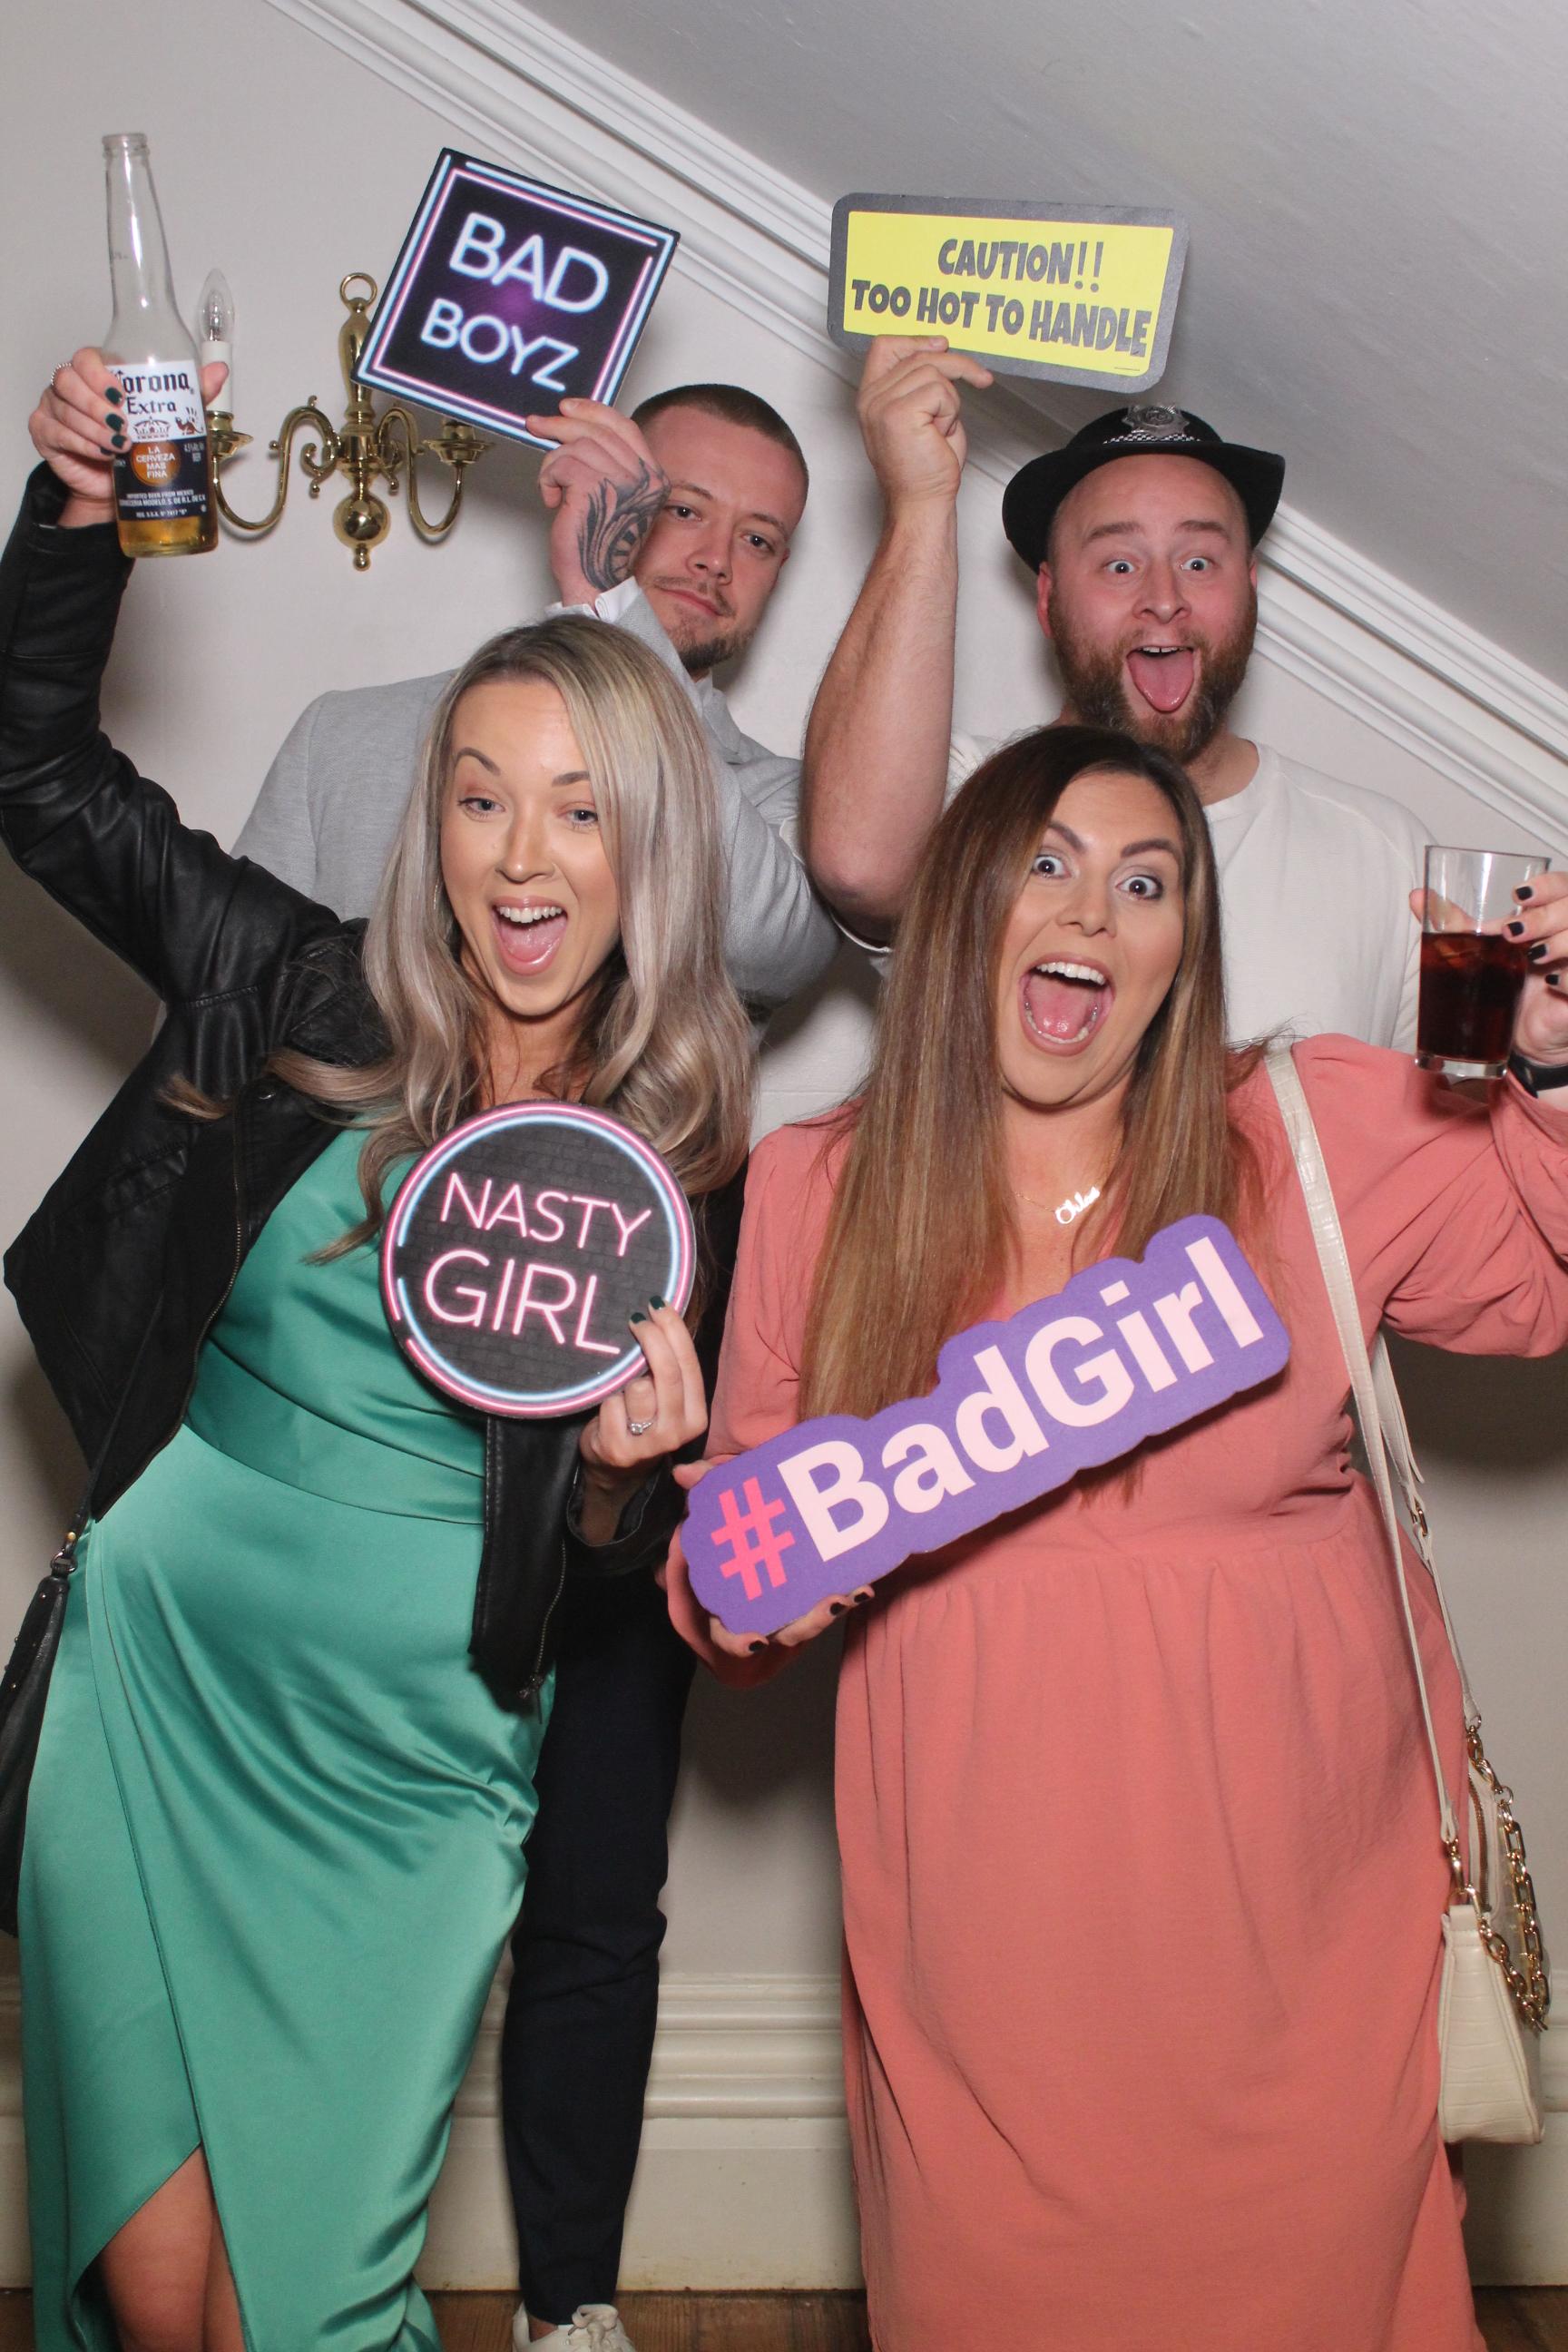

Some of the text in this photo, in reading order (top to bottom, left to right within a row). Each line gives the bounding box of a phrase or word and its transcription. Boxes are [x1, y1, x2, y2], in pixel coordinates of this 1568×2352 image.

[449, 211, 609, 313] BAD
[937, 238, 1104, 293] CAUTION!!
[420, 298, 579, 392] BOYZ
[851, 279, 1152, 358] TOO HOT TO HANDLE
[111, 370, 191, 395] orona
[125, 396, 177, 415] Extra
[136, 453, 176, 463] CERVEZA
[146, 470, 168, 480] FINA
[147, 446, 161, 454] LA
[439, 1171, 652, 1258] NASTY
[423, 1249, 622, 1356] GIRL
[710, 1236, 1264, 1602] #BadGirl
